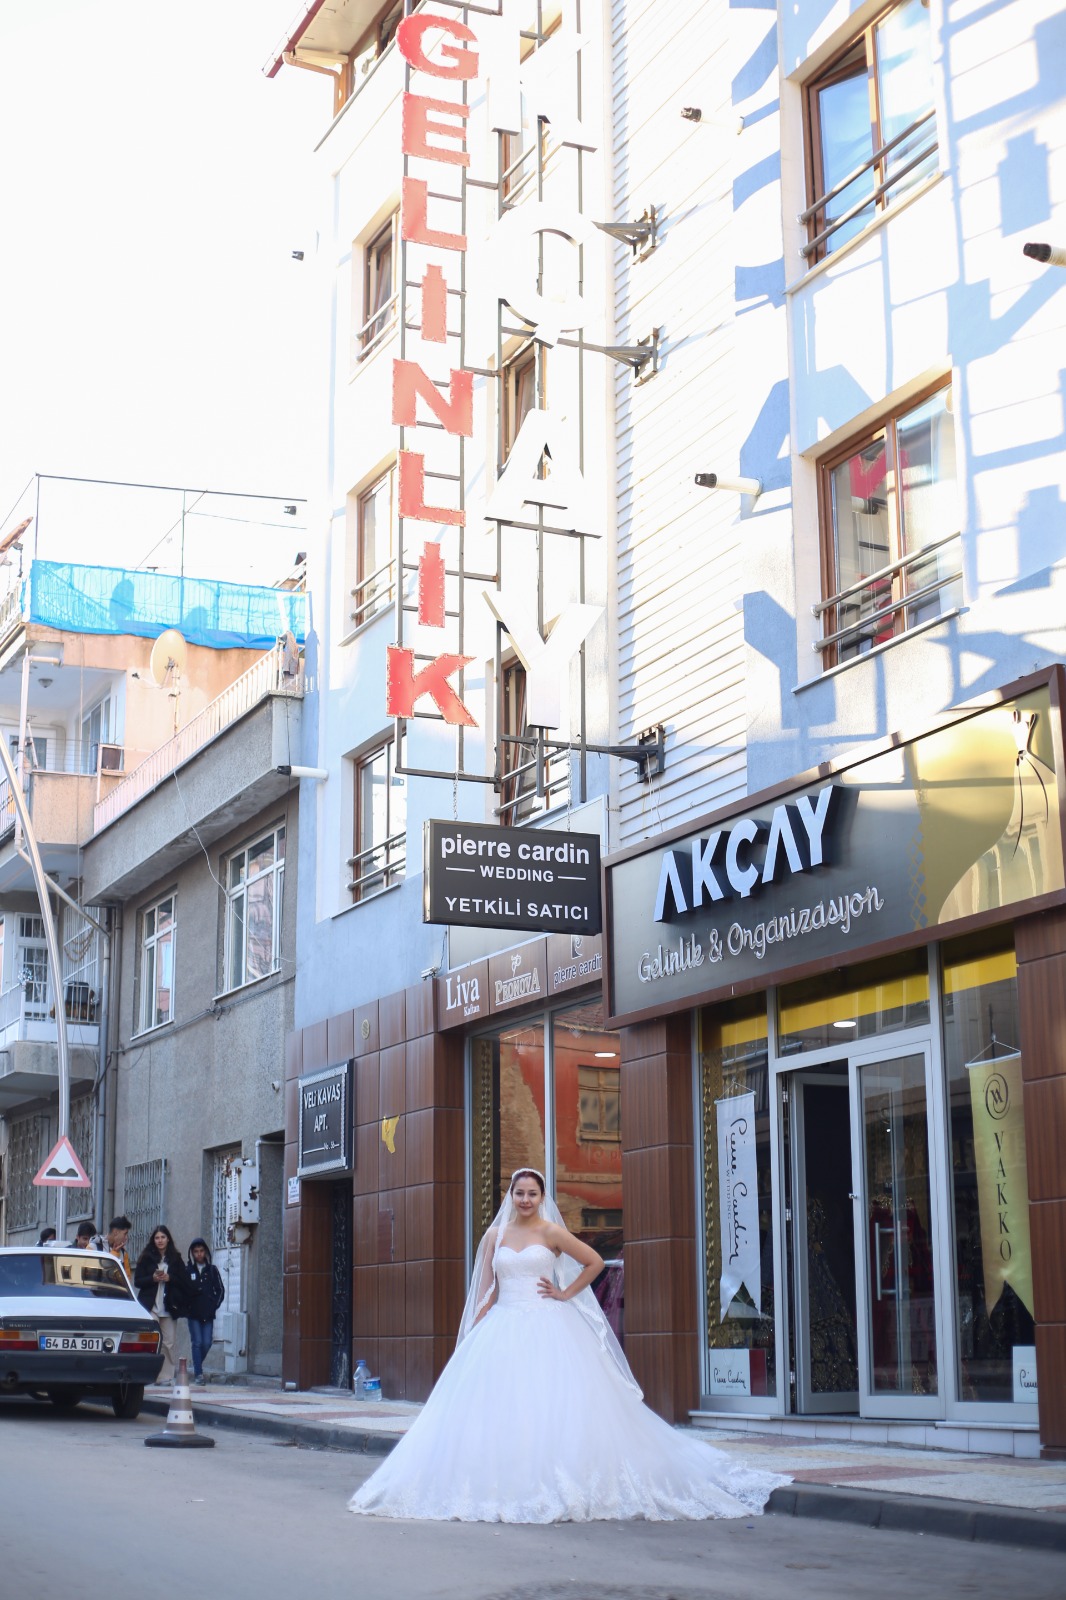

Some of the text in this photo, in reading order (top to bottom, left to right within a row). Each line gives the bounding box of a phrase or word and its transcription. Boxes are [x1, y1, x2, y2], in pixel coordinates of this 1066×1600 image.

[386, 12, 480, 728] GELİNLİK
[441, 834, 590, 865] pierre cardin
[654, 785, 834, 923] AKÇAY
[480, 865, 554, 883] WEDDING
[445, 896, 588, 920] YETKİLİ SATICI
[637, 886, 885, 984] Gelinlik & Organizasyon
[446, 975, 480, 1010] Liva
[553, 969, 577, 989] pierre
[313, 1114, 328, 1133] APT.
[993, 1130, 1013, 1262] VAKKO
[45, 1338, 101, 1350] 64 BA 901
